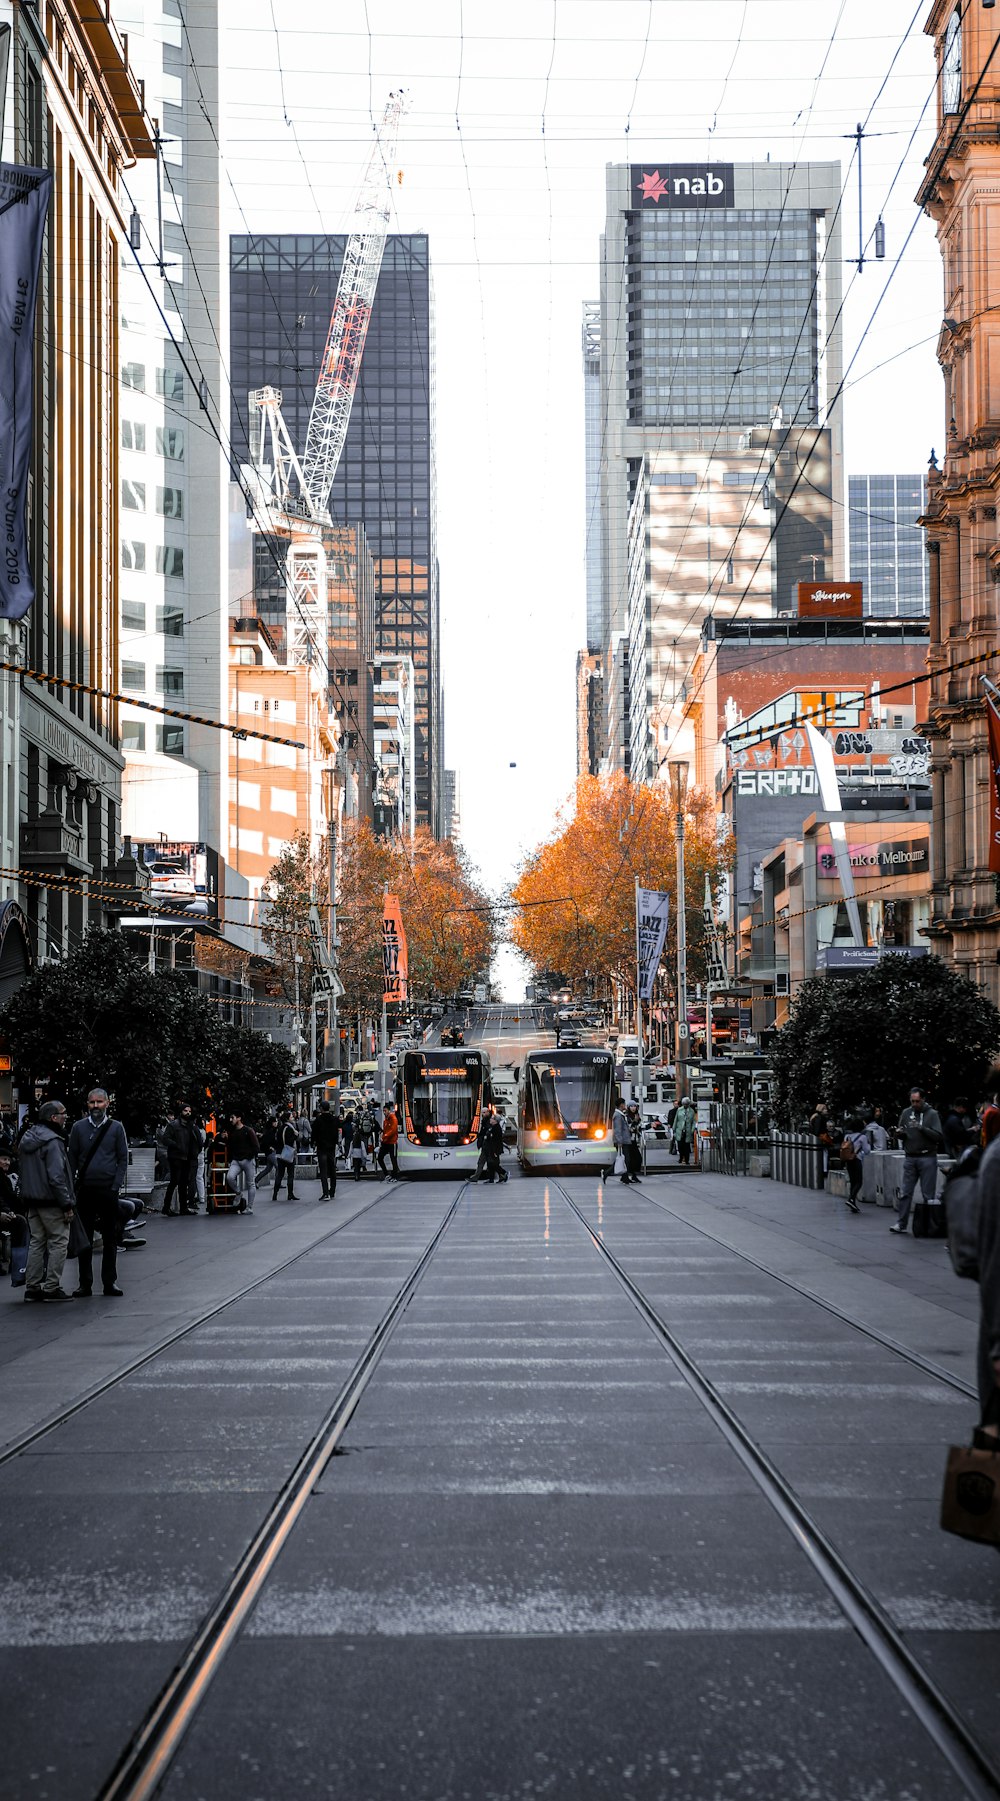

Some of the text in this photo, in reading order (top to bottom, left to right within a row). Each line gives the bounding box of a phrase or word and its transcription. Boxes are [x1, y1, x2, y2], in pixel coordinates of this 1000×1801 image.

[673, 172, 724, 195] nab
[16, 278, 29, 296] 31
[10, 300, 27, 337] May
[5, 501, 17, 543] June
[5, 548, 21, 585] 2019
[868, 852, 882, 866] of
[882, 849, 925, 866] Melbourne
[465, 1057, 479, 1065] 6026
[592, 1056, 609, 1064] 6067
